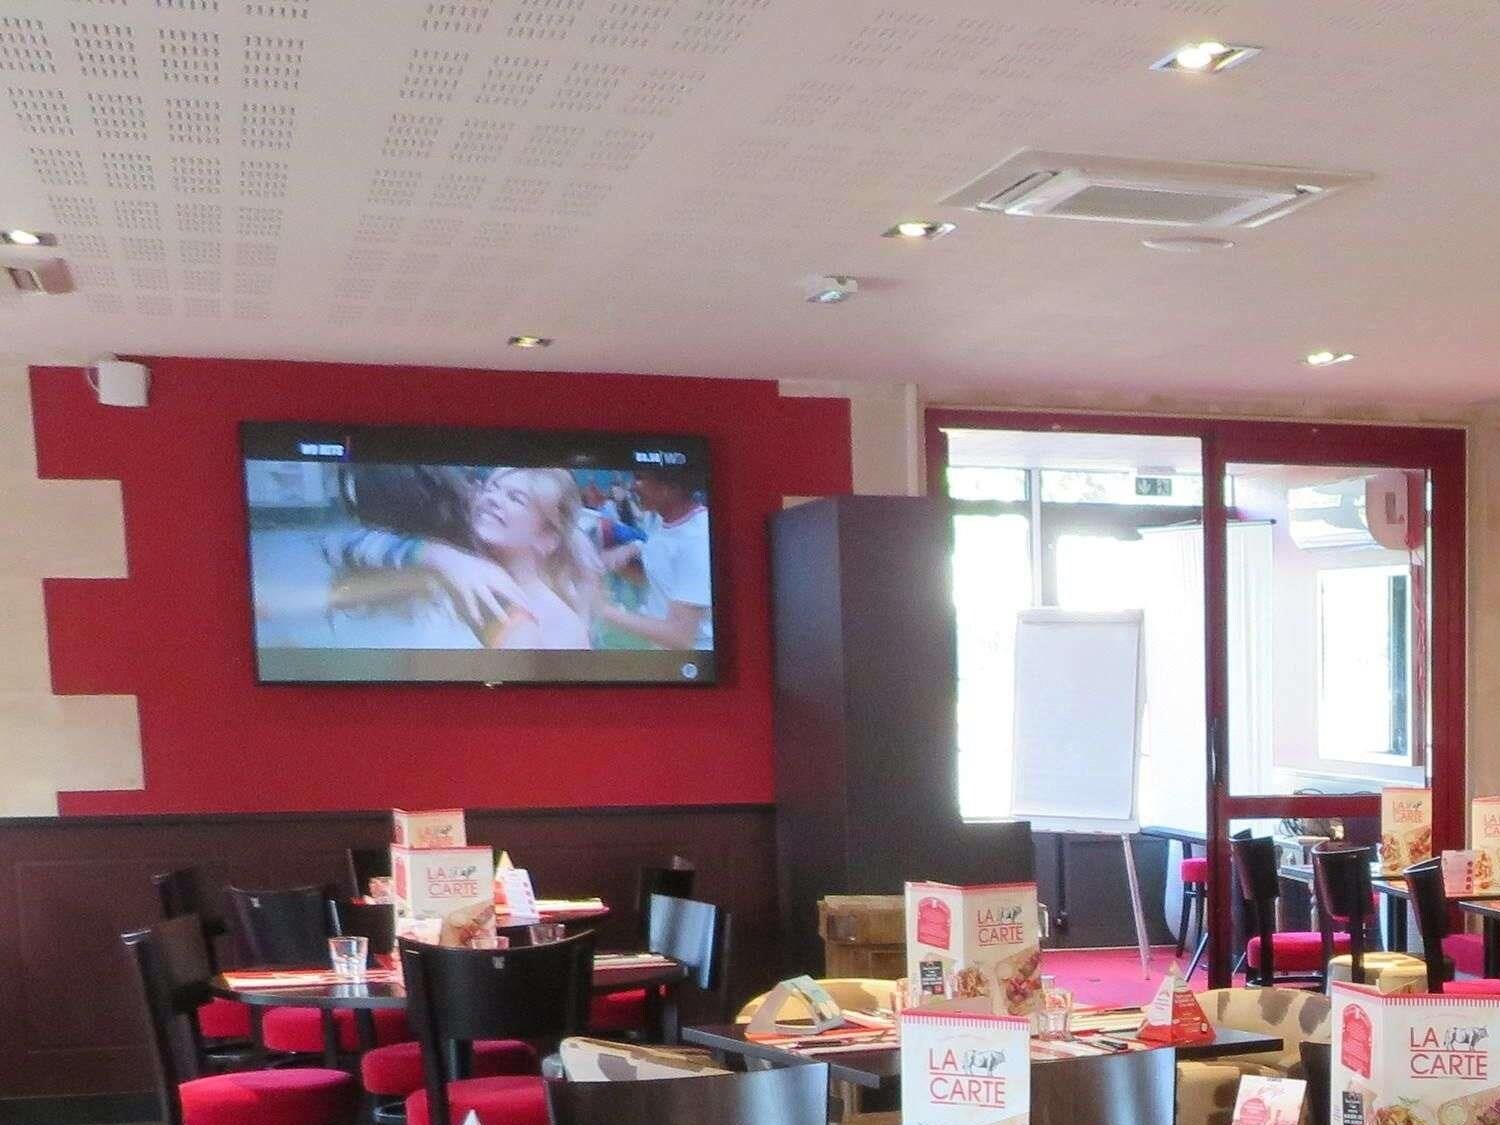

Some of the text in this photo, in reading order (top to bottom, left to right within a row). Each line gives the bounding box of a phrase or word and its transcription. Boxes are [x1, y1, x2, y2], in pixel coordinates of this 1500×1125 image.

[427, 866, 447, 879] LA
[428, 882, 478, 896] CARTE
[977, 908, 994, 924] LA
[978, 926, 1024, 944] CARTE
[1409, 1026, 1440, 1048] LA
[929, 1047, 959, 1072] LA
[1410, 1053, 1488, 1077] CARTE
[929, 1077, 1006, 1105] CARTE
